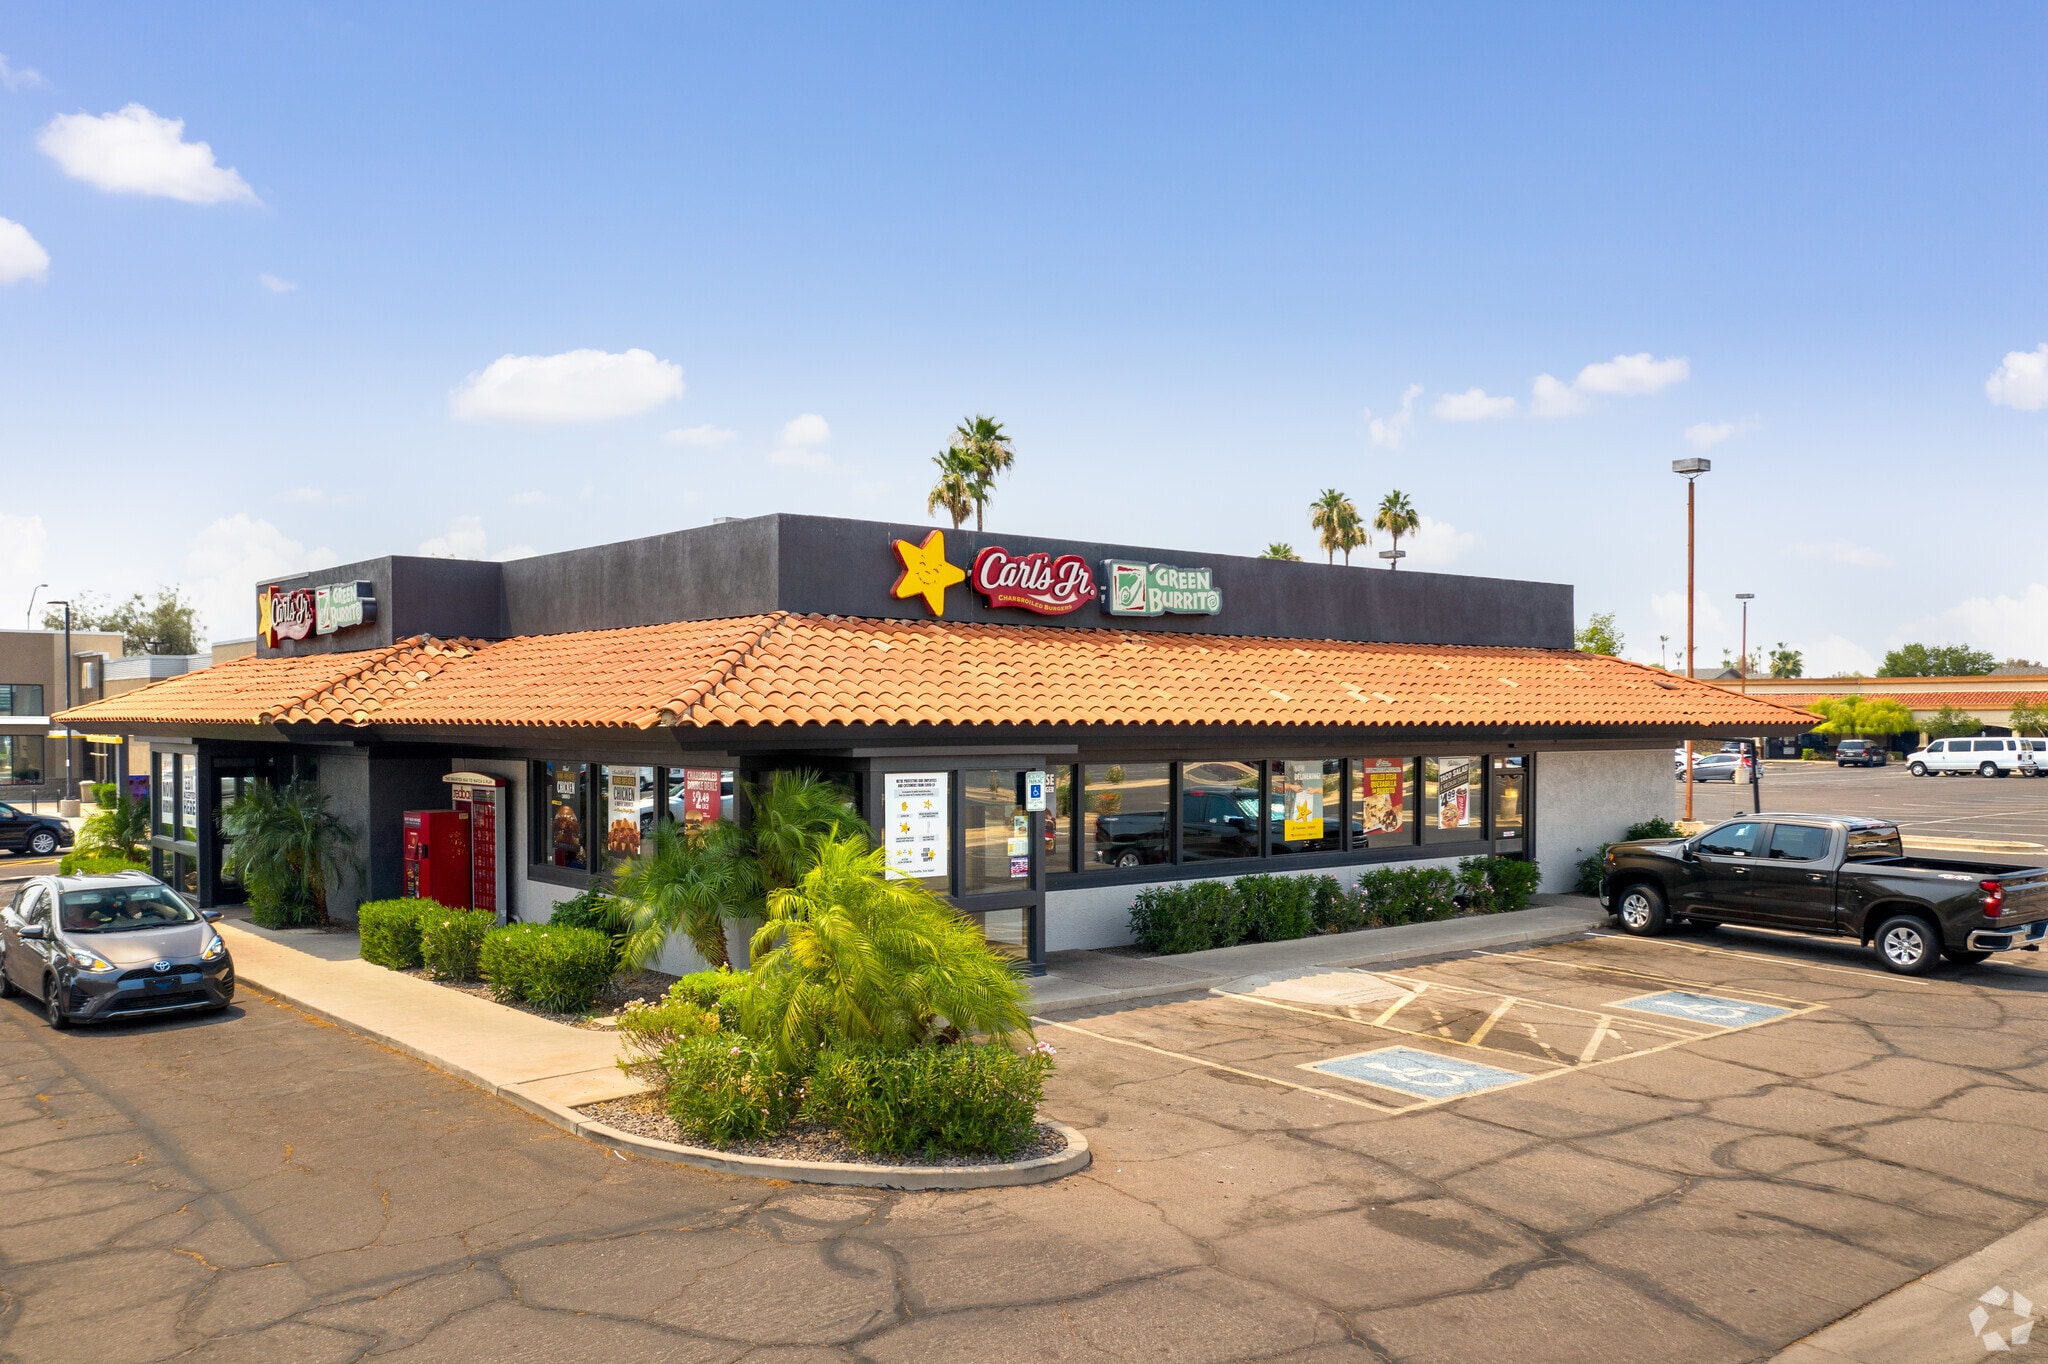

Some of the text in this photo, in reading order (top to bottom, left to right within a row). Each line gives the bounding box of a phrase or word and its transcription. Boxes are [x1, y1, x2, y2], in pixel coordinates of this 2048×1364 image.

[980, 552, 1095, 597] Carl's Jr.
[1155, 568, 1210, 589] GREEN
[332, 585, 357, 604] GREEN
[998, 594, 1073, 611] CHARBROILED BURGERS
[1148, 588, 1219, 612] BURRITO
[271, 593, 313, 626] Carl's Jr.
[330, 602, 362, 628] BURRITO
[1440, 765, 1468, 782] TACO SALAD
[453, 786, 471, 799] redbo
[557, 781, 576, 794] CHICKEN
[613, 786, 635, 801] CHICKEN
[686, 781, 718, 791] DOUBLE DEALS
